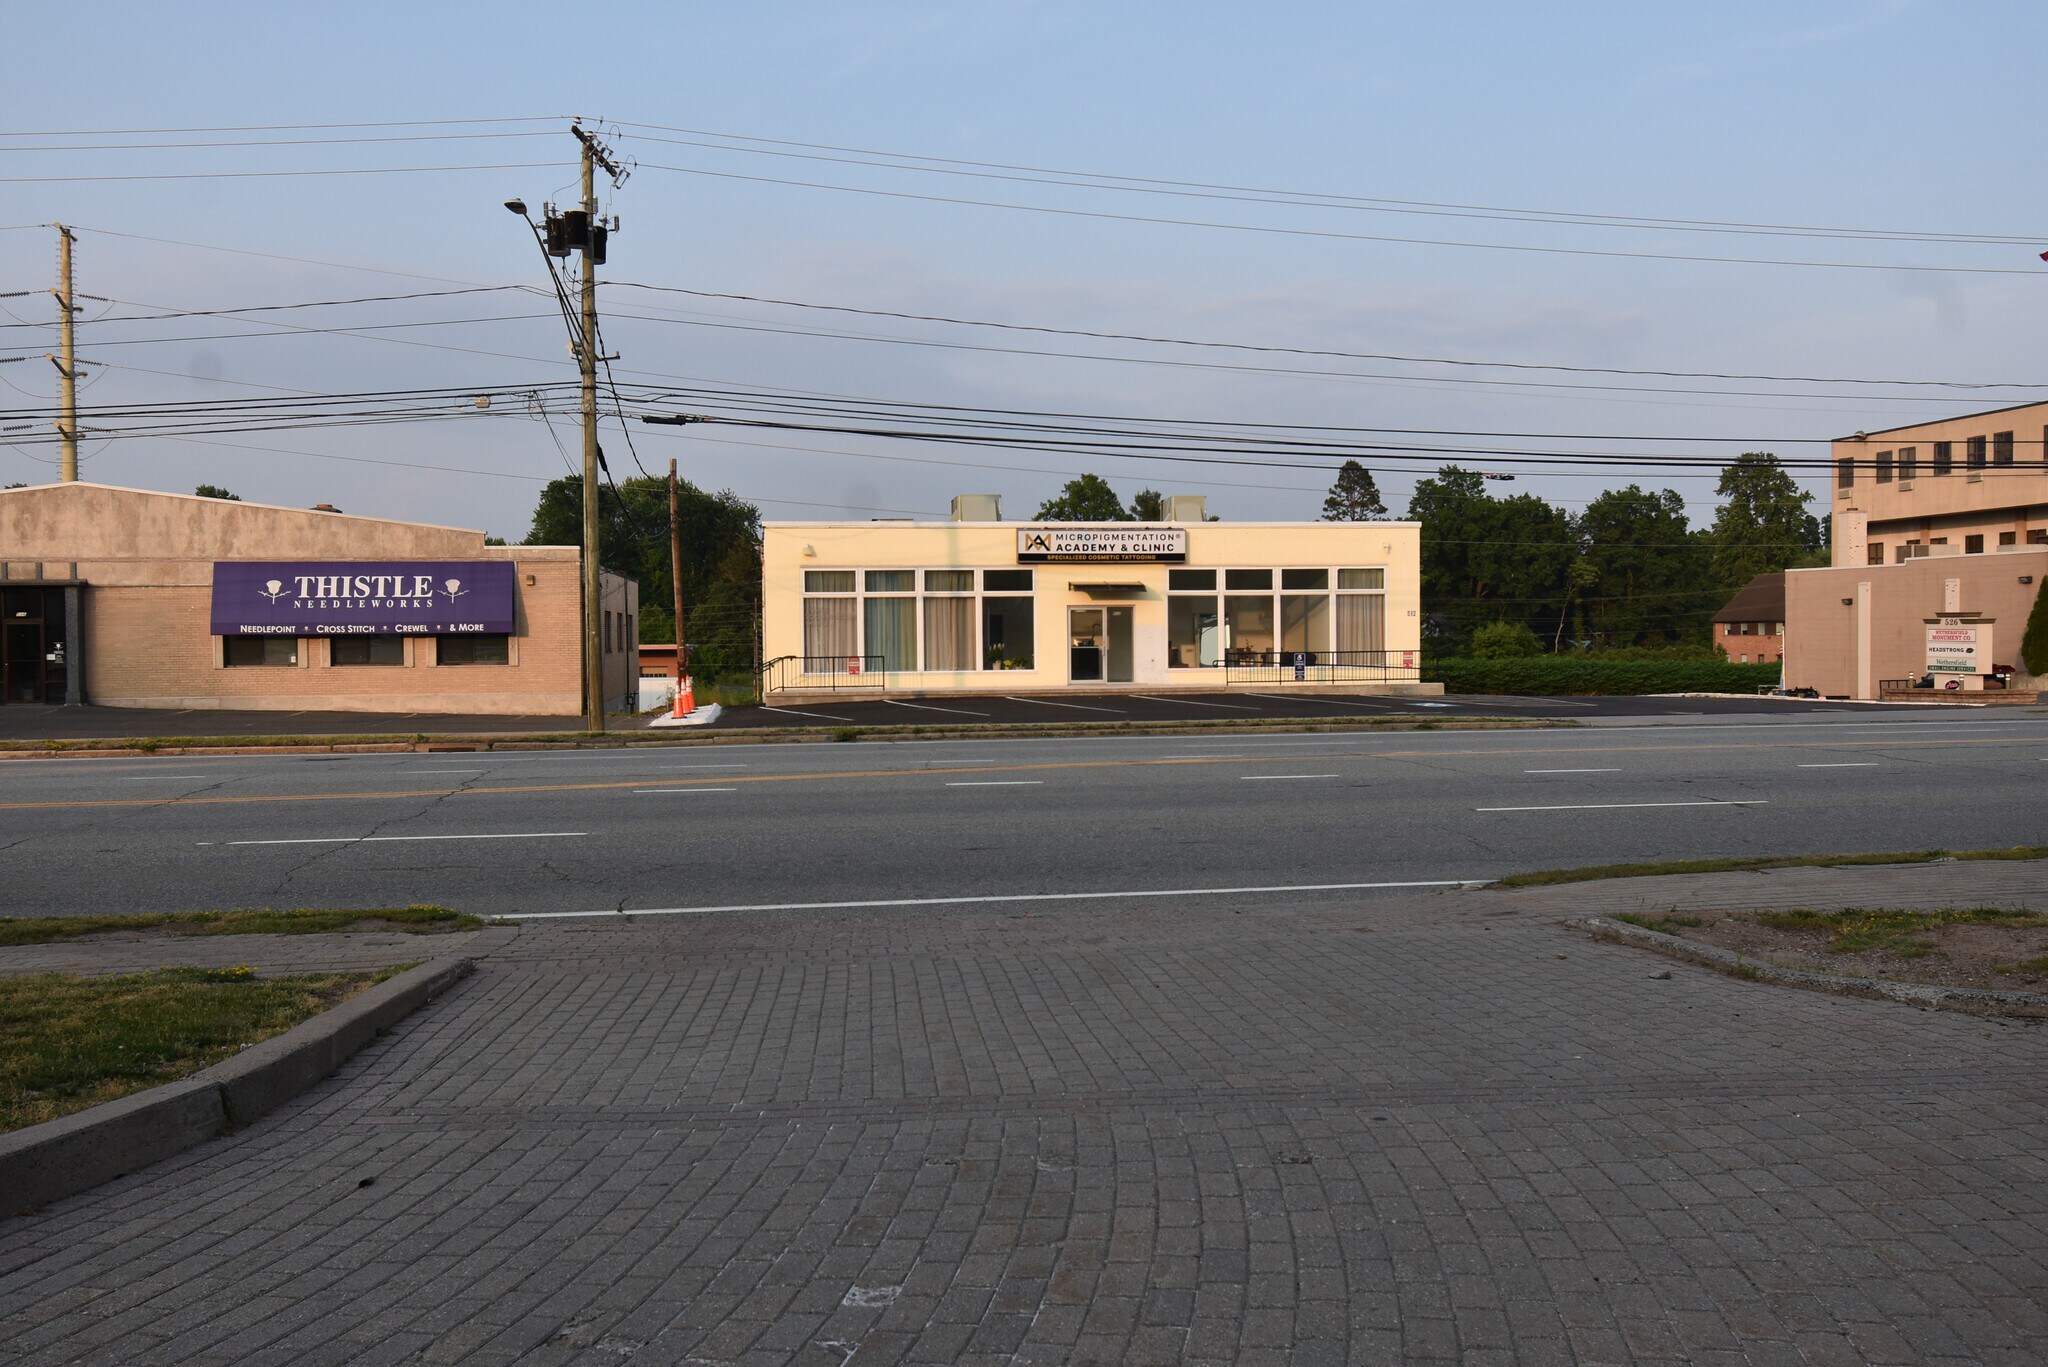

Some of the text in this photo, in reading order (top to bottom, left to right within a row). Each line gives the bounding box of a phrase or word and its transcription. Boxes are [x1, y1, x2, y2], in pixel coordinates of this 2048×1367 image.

[1056, 543, 1175, 552] ACADEMY & CLINIC
[294, 575, 433, 598] THISTLE
[293, 600, 433, 609] NEEDLEWORKS
[449, 623, 456, 632] &
